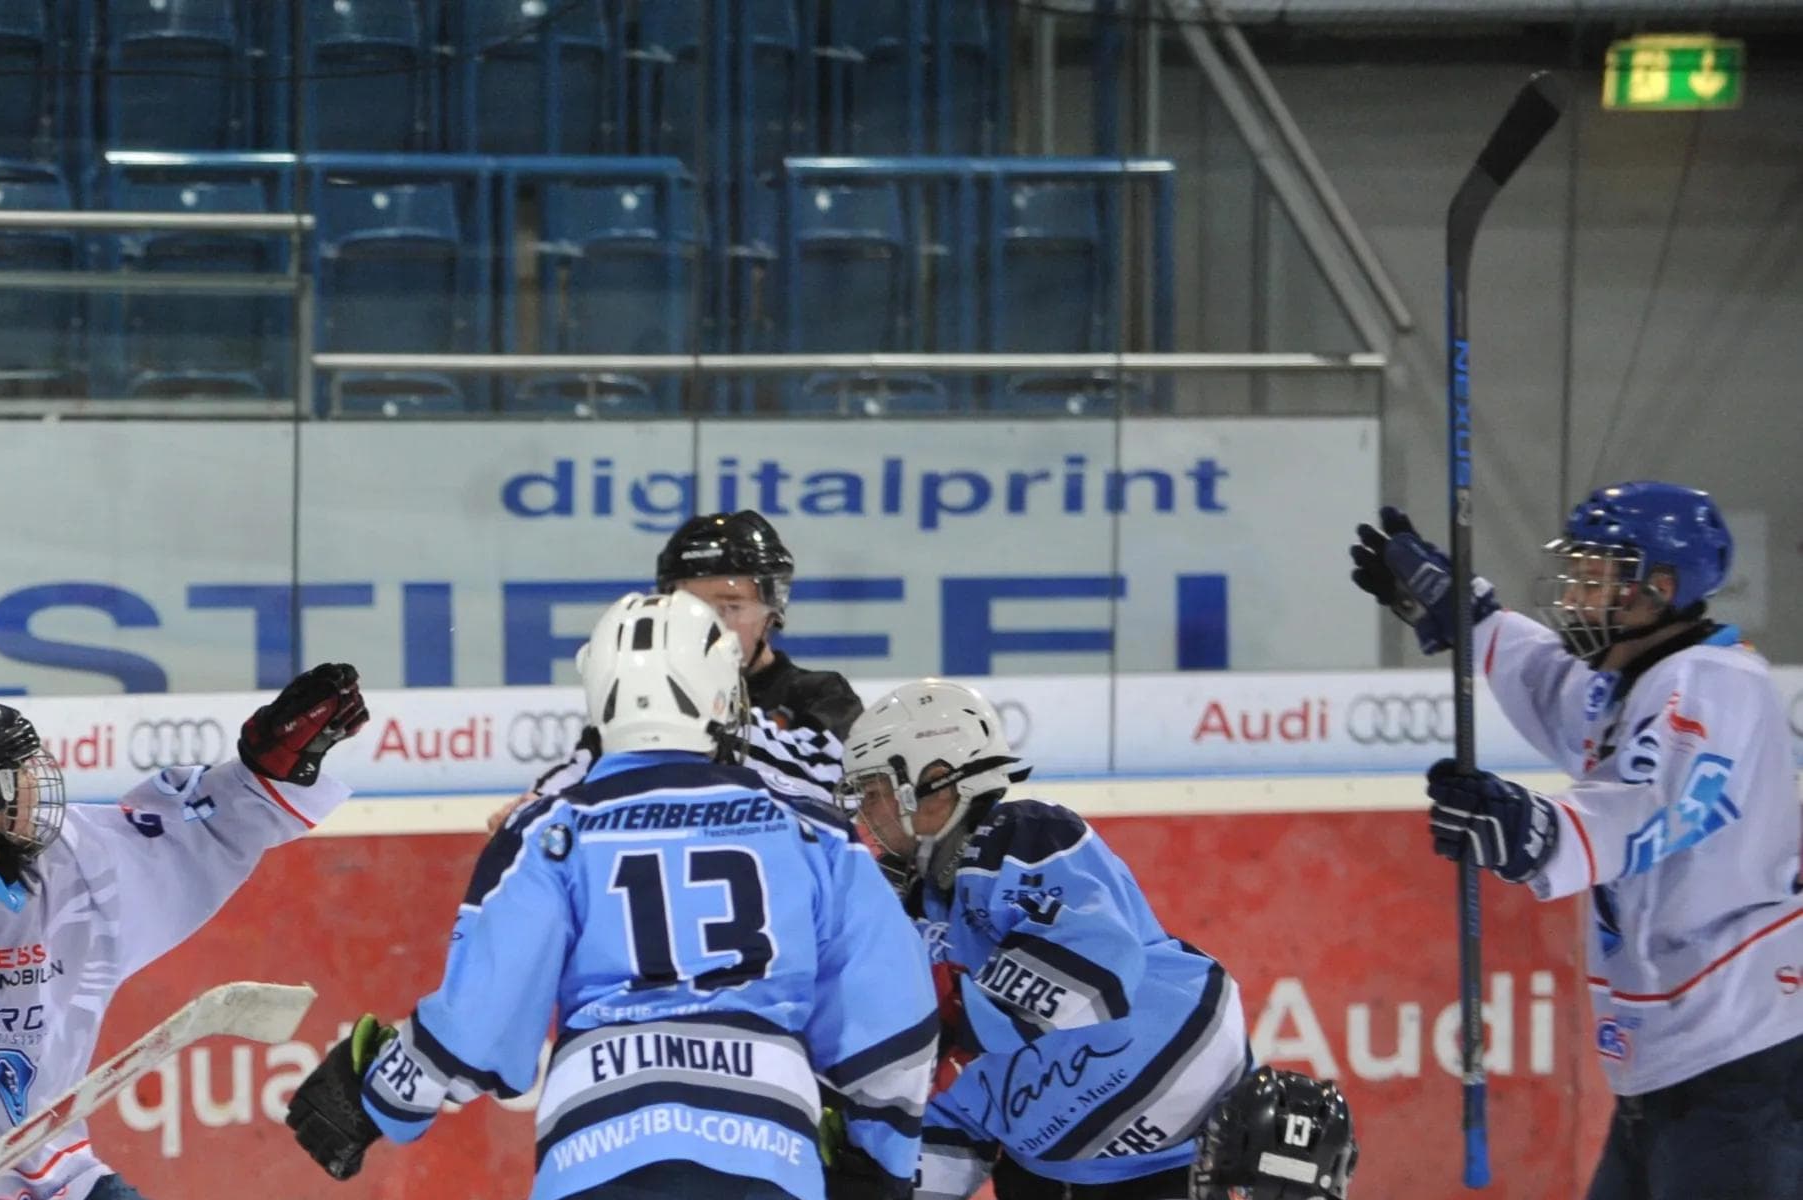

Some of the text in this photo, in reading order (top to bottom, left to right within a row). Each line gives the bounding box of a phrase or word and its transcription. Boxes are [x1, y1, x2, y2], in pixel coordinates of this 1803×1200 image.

[500, 454, 1230, 533] digitalprint
[372, 717, 494, 764] Audi
[1193, 699, 1329, 744] Audi
[37, 726, 115, 770] udi
[607, 846, 779, 996] 13
[1252, 970, 1555, 1082] Audi
[590, 1033, 754, 1083] EV LINDAU
[1079, 1068, 1129, 1108] Music
[553, 1107, 804, 1172] WWW.FIBU.COM.DE
